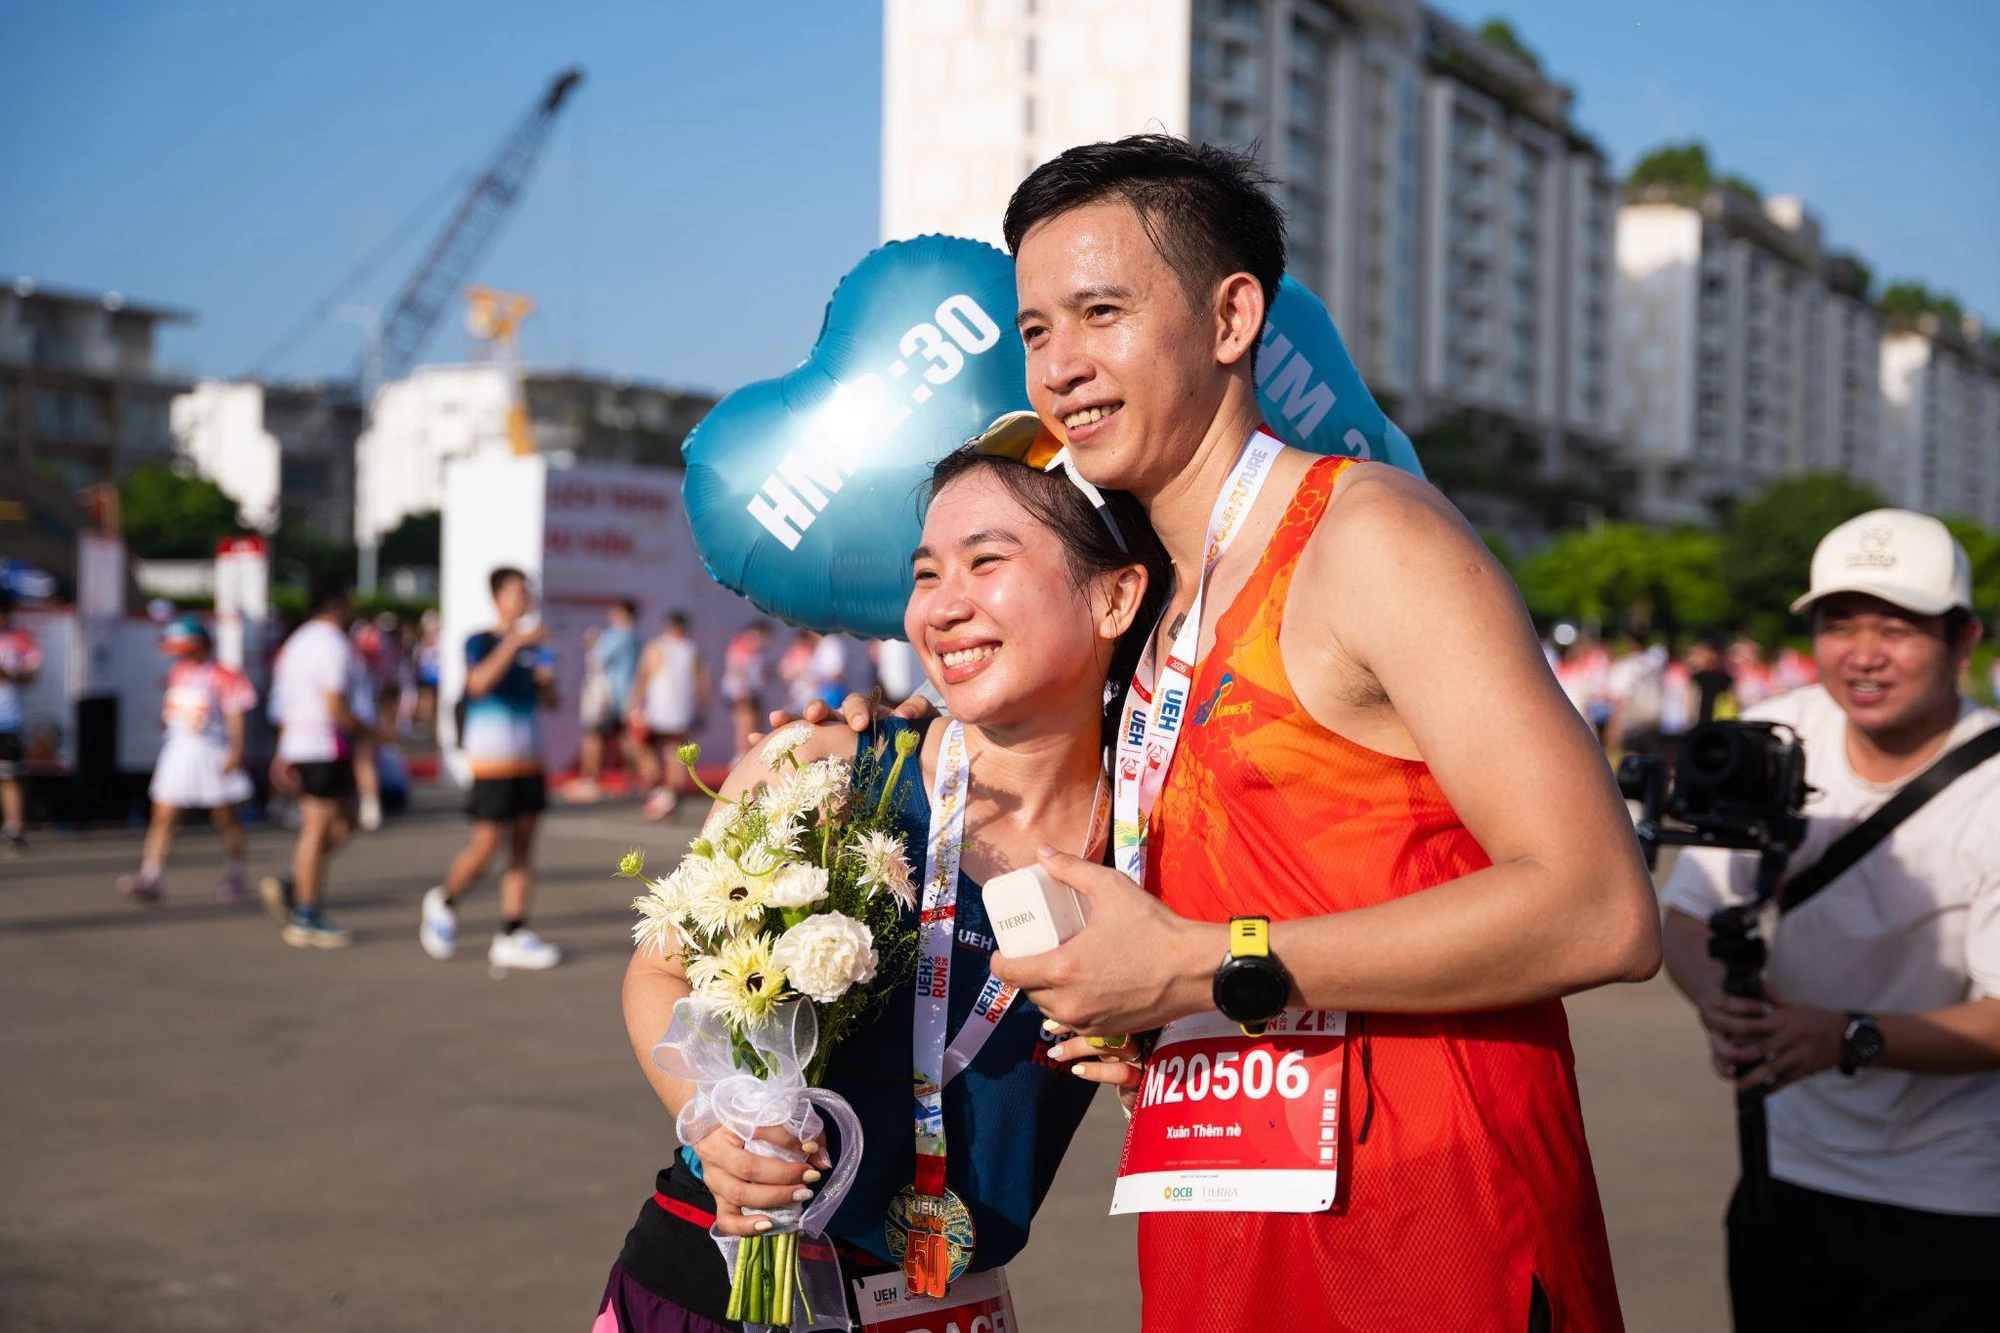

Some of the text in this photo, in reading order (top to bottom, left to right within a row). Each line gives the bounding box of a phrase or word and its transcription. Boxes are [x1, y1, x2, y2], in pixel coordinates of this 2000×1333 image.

[1170, 659, 1188, 674] 2026
[1123, 706, 1133, 744] UNIVERSITY
[1158, 688, 1184, 733] UEH
[1127, 709, 1147, 747] UEH
[997, 910, 1036, 932] TIERRA
[957, 928, 994, 950] UEH
[918, 964, 933, 997] UEH
[932, 966, 945, 999] RUN
[974, 983, 997, 1017] UEH
[985, 992, 1012, 1025] RUN
[1142, 1049, 1310, 1109] M20506
[1166, 1122, 1242, 1139] Xuân Thêm nè
[1172, 1186, 1193, 1199] OCB
[1202, 1186, 1239, 1198] TIERRA
[873, 1287, 897, 1303] UEH
